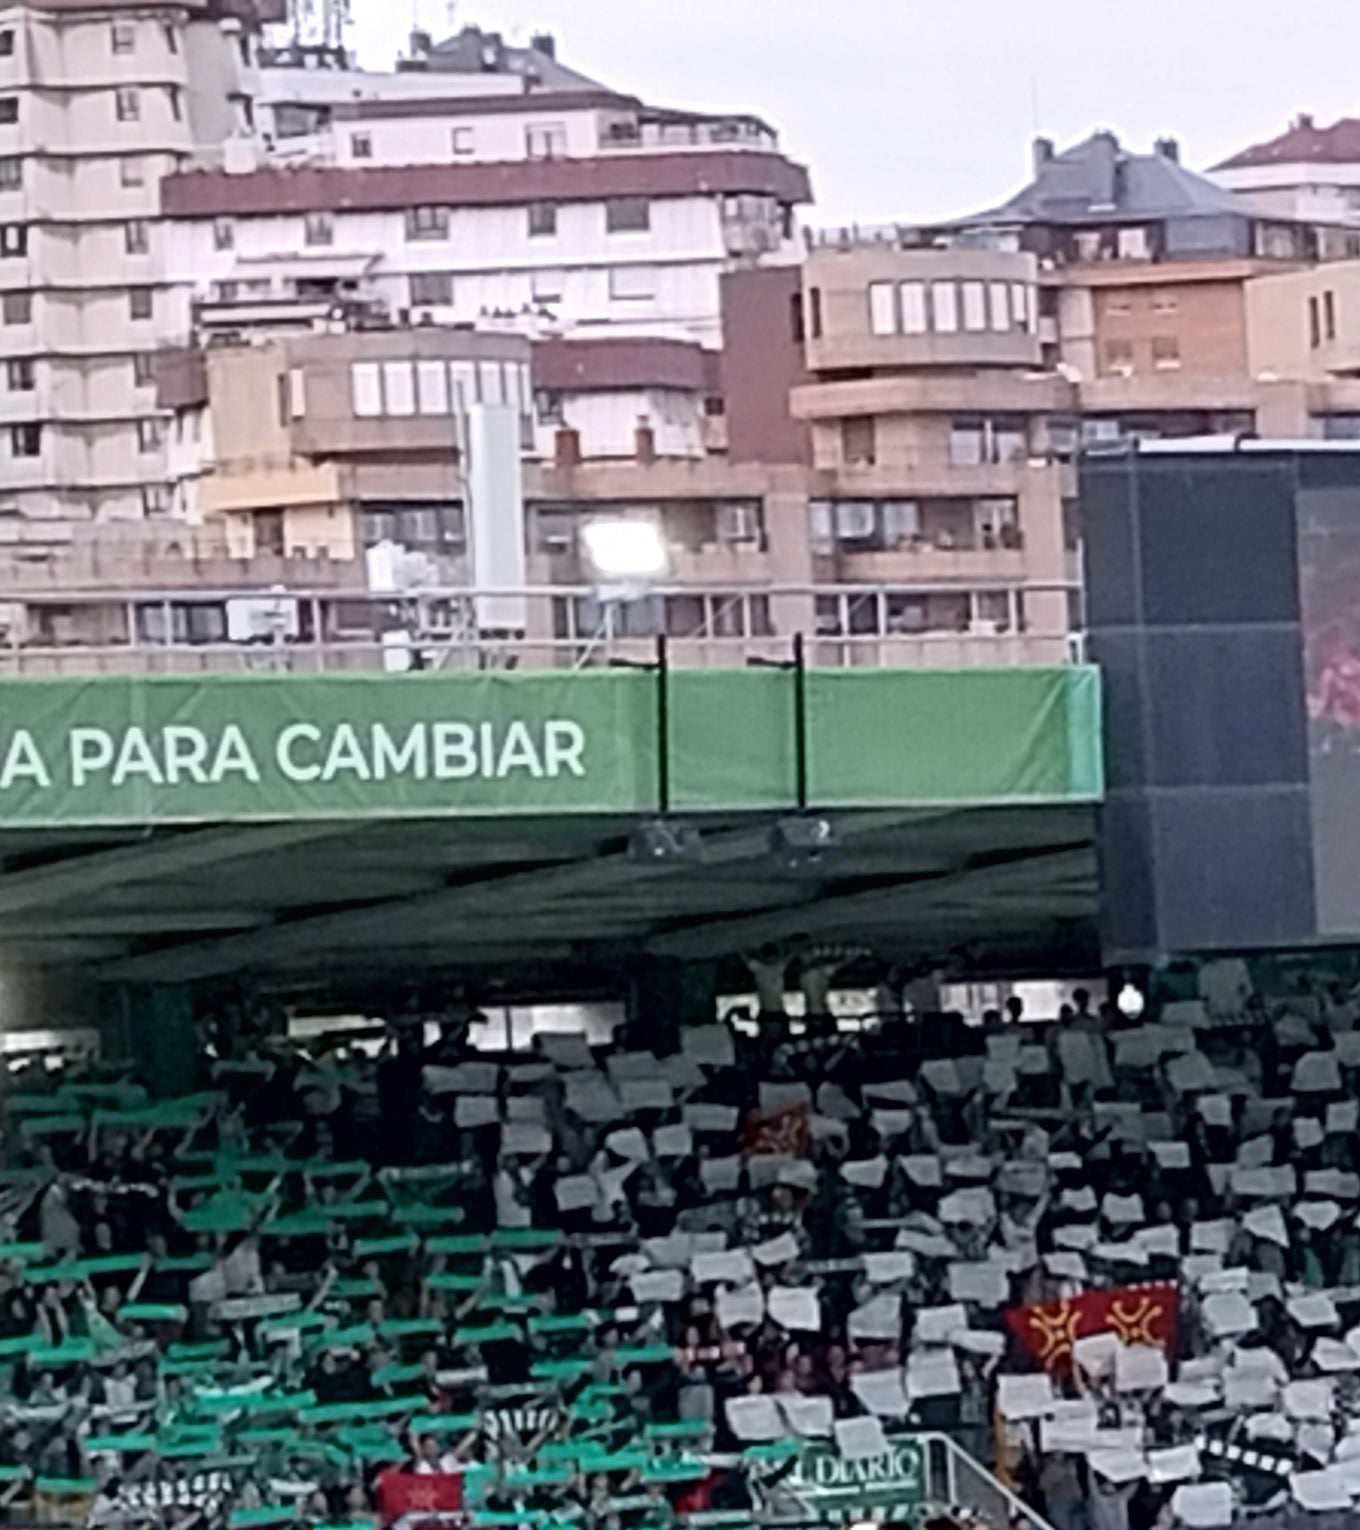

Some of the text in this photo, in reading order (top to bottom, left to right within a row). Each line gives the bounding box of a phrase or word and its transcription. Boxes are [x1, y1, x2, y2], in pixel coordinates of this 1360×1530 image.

[70, 725, 260, 787] PARA
[276, 719, 586, 782] CAMBIAR
[816, 1446, 920, 1484] DIARIO
